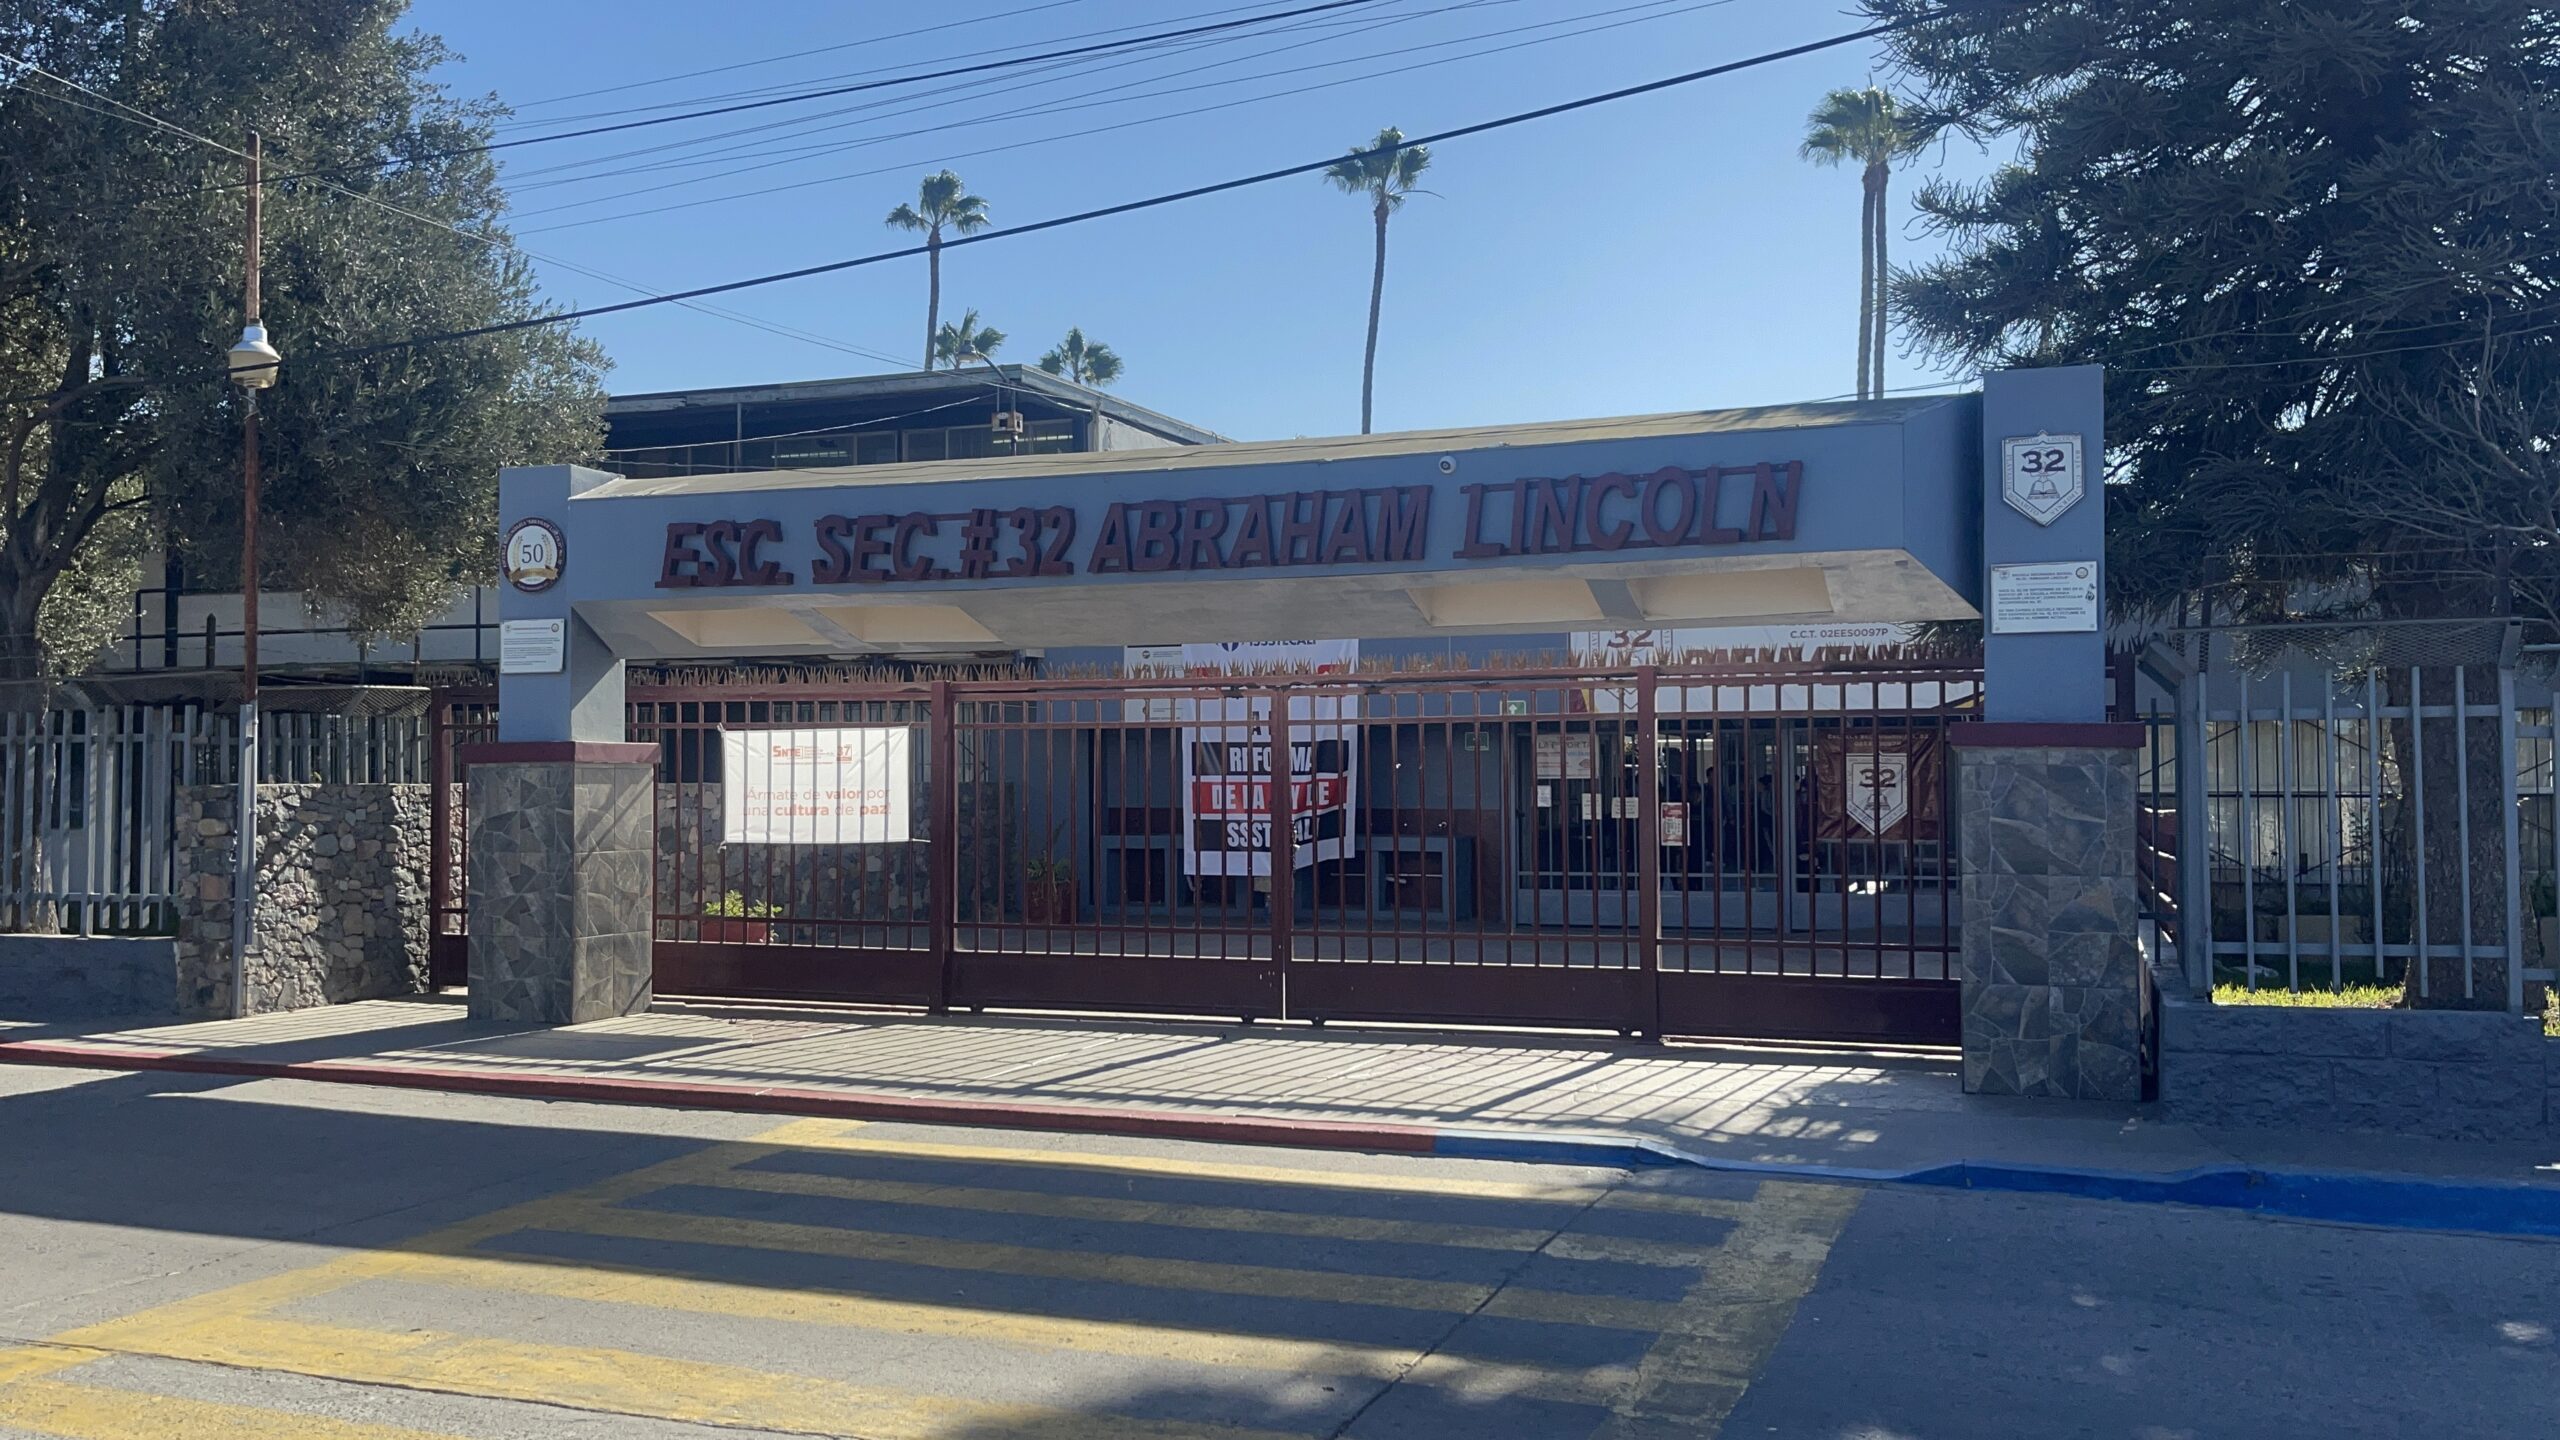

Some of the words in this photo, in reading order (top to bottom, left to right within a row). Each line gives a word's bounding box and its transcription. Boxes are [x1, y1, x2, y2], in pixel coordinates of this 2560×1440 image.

[2021, 448, 2066, 473] 32
[655, 519, 795, 589] ESC.
[812, 511, 950, 585] SEC.
[959, 506, 1076, 579] #32
[1087, 484, 1434, 573] ABRAHAM
[1452, 459, 1804, 560] LINCOLN
[521, 543, 544, 564] 50
[1790, 630, 1818, 639] C.C.T.
[1820, 628, 1889, 639] 02EES0097P
[1859, 768, 1897, 788] 32
[803, 788, 821, 800] de
[826, 788, 863, 800] valor
[866, 789, 890, 801] por
[743, 806, 769, 817] una
[774, 804, 830, 817] cultura
[835, 804, 855, 817] de
